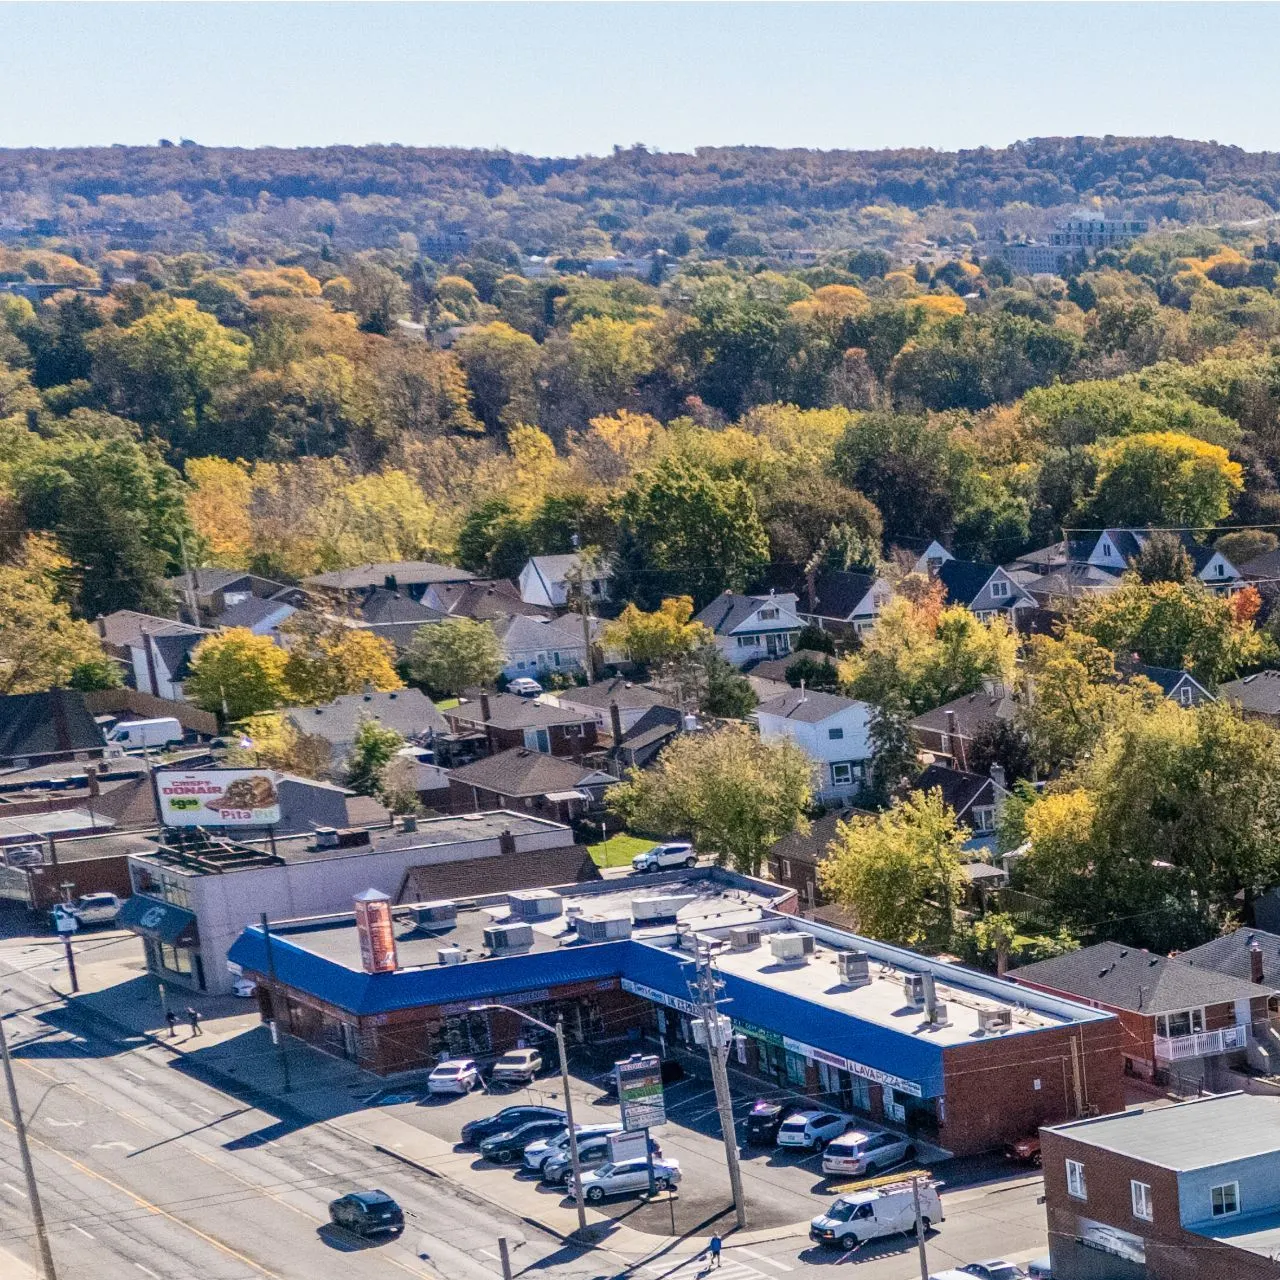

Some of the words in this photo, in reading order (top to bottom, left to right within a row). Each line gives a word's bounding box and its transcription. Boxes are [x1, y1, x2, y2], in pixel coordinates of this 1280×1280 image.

[162, 786, 222, 795] DONAIR
[221, 810, 251, 819] Pita
[854, 1063, 876, 1080] LAVA
[876, 1071, 900, 1088] PIZZA
